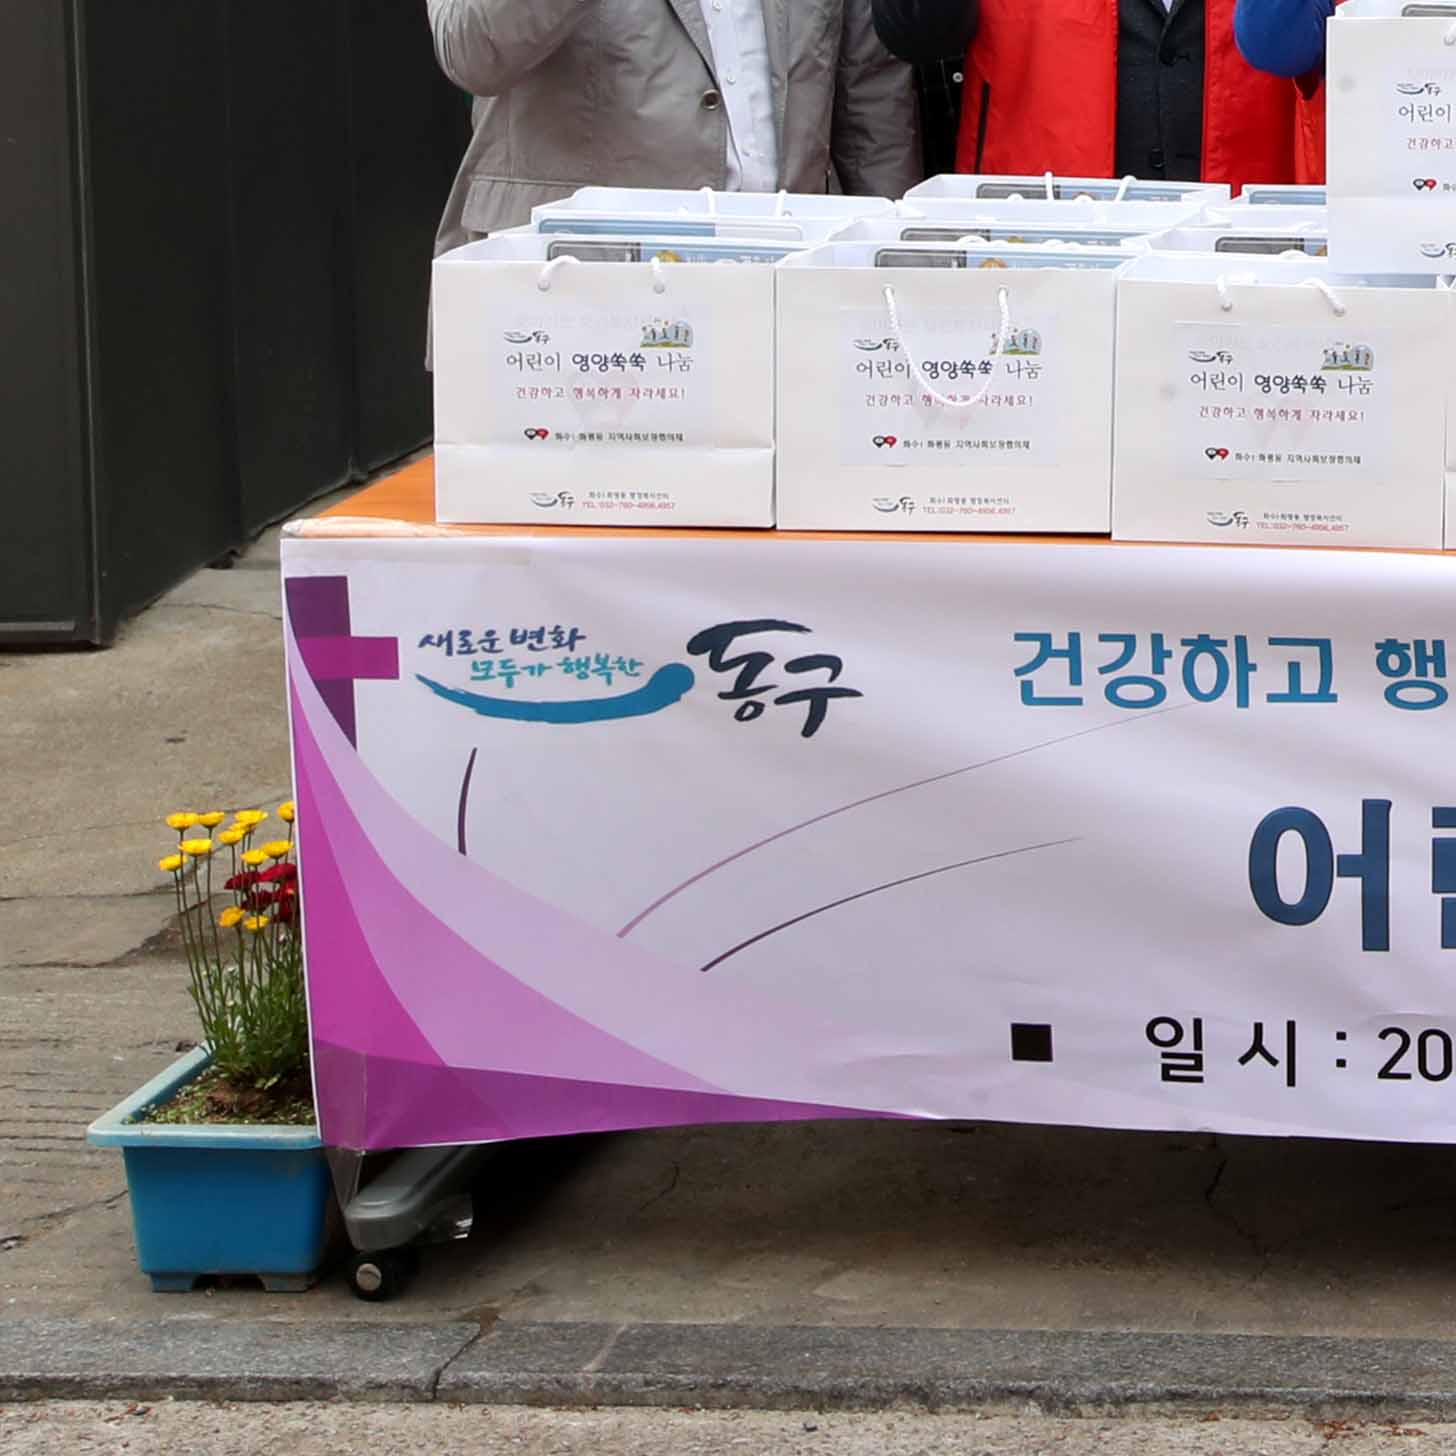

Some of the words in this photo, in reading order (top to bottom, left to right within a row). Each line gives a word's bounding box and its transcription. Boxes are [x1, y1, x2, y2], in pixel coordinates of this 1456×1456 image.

[1399, 104, 1451, 124] 어린이
[1408, 138, 1454, 149] 건강하고
[507, 353, 561, 373] 어린이
[572, 353, 646, 373] 영양쑥쑥
[658, 352, 694, 372] 나눔
[857, 360, 910, 380] 어린이
[1007, 360, 1042, 380] 나눔
[517, 387, 565, 399] 건강하고
[630, 387, 686, 399] 자라세요!
[1191, 372, 1243, 392] 어린이
[1255, 374, 1327, 394] 영양쑥쑥
[1338, 376, 1373, 396] 나눔
[867, 394, 914, 406] 건강하고
[1200, 407, 1246, 418] 건강하고
[1310, 409, 1364, 422] 자라세요!
[418, 629, 504, 657] 새로운
[509, 625, 587, 652] 변화
[467, 651, 546, 688] 모두가
[556, 649, 645, 685] 행복한
[682, 619, 864, 738] 동구
[1014, 632, 1338, 709] 건강하고
